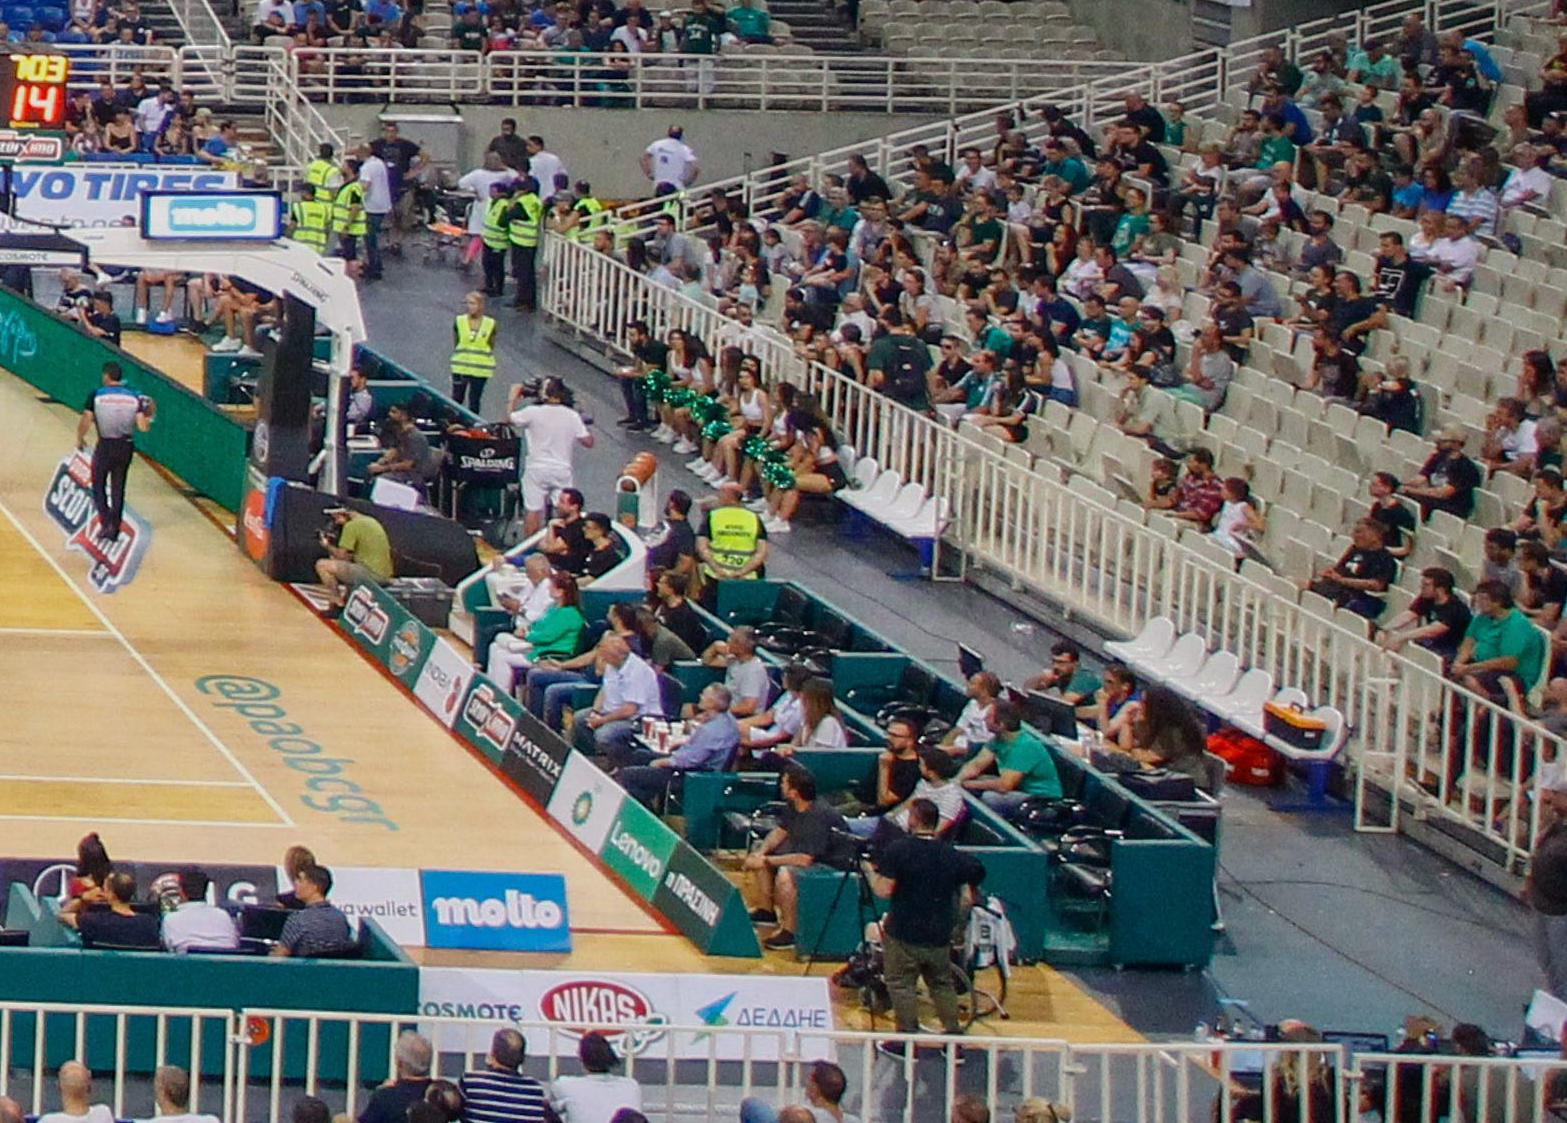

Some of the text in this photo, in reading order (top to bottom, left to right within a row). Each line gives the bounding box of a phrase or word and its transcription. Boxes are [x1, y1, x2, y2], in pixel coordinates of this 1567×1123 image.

[12, 84, 58, 123] 14
[460, 456, 515, 470] SPALDING
[195, 674, 401, 832] @paobcgr
[512, 730, 564, 778] MATRIX
[610, 820, 663, 879] Lenovo
[432, 888, 563, 929] molto
[552, 986, 637, 1023] NIKAS
[736, 1007, 828, 1028] ΔΕΔΔΗΕ
